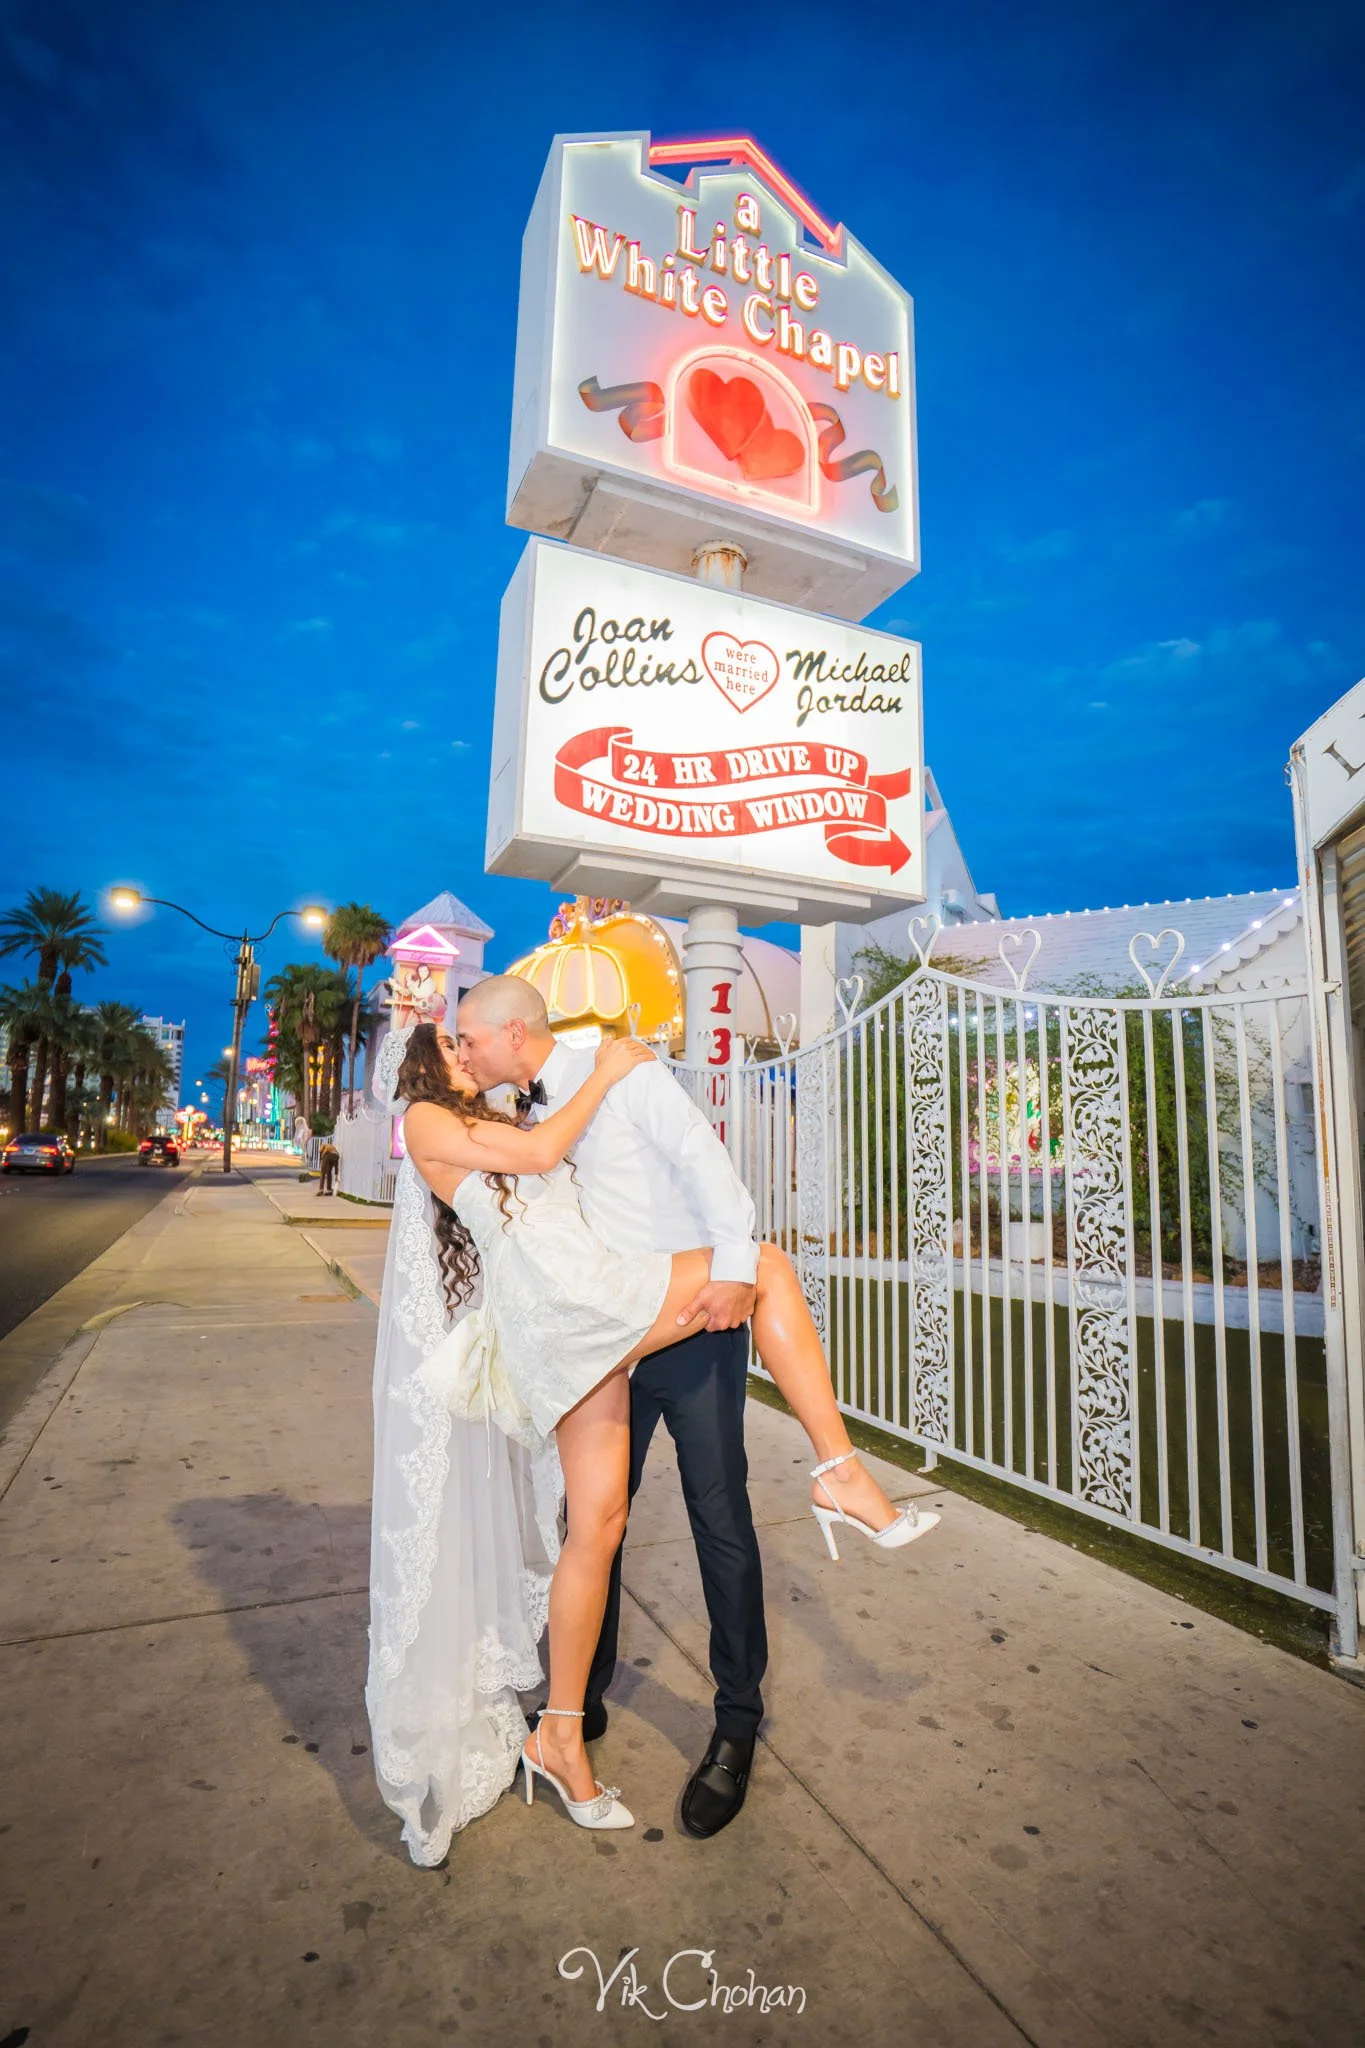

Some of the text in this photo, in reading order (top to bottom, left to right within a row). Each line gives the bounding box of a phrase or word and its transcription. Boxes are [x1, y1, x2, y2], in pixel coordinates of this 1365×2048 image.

[735, 192, 762, 236] a
[676, 205, 819, 311] Little
[569, 213, 901, 400] White Chapel
[573, 607, 674, 665] Joan
[726, 648, 757, 664] were
[538, 647, 704, 704] Collins
[714, 661, 768, 682] married
[726, 676, 756, 695] here
[785, 649, 912, 684] Michael
[796, 685, 904, 728] Jordan
[622, 745, 860, 787] 24 HR DRIVE UP
[581, 779, 869, 834] WEDDING WINDOW
